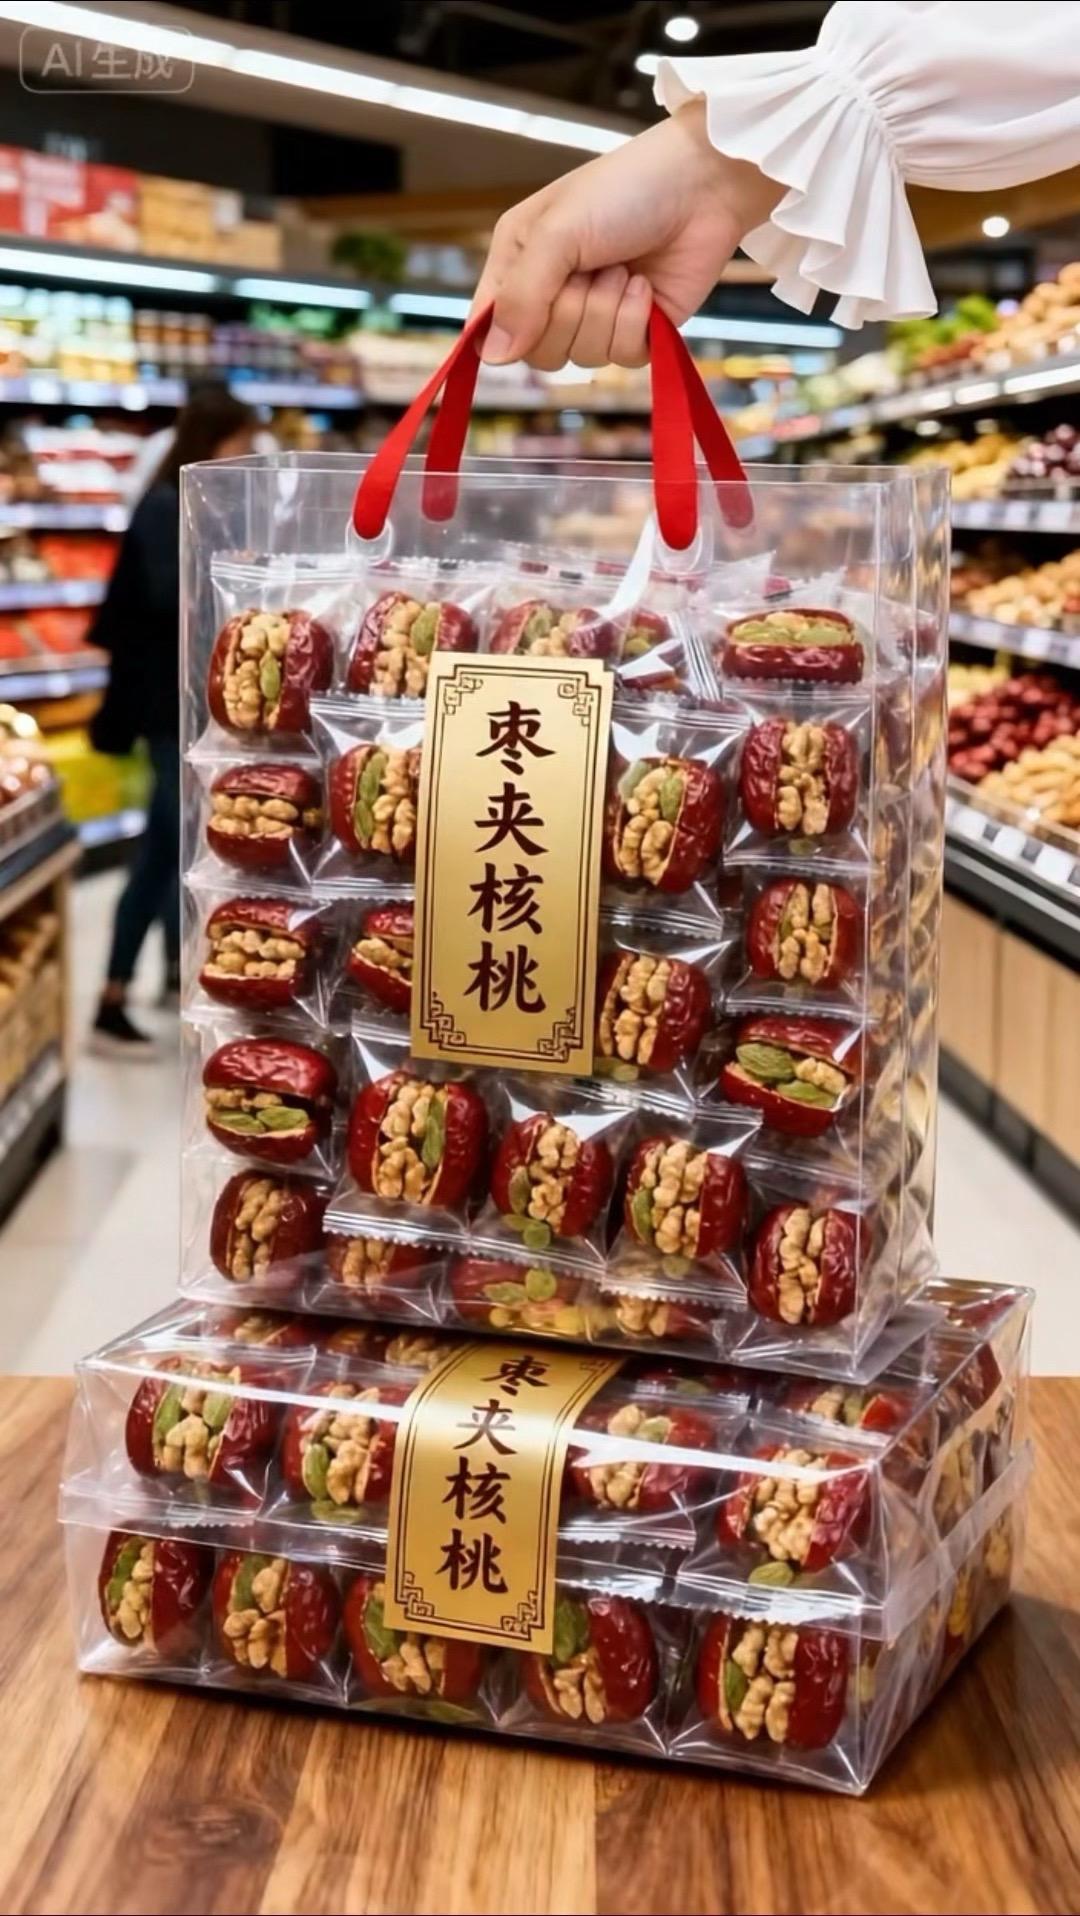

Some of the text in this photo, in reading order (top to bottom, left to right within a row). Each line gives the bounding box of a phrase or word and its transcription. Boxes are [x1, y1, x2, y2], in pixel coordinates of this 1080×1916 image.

[463, 700, 556, 1014] 枣夹核桃
[435, 1355, 550, 1594] 枣夹核桃
